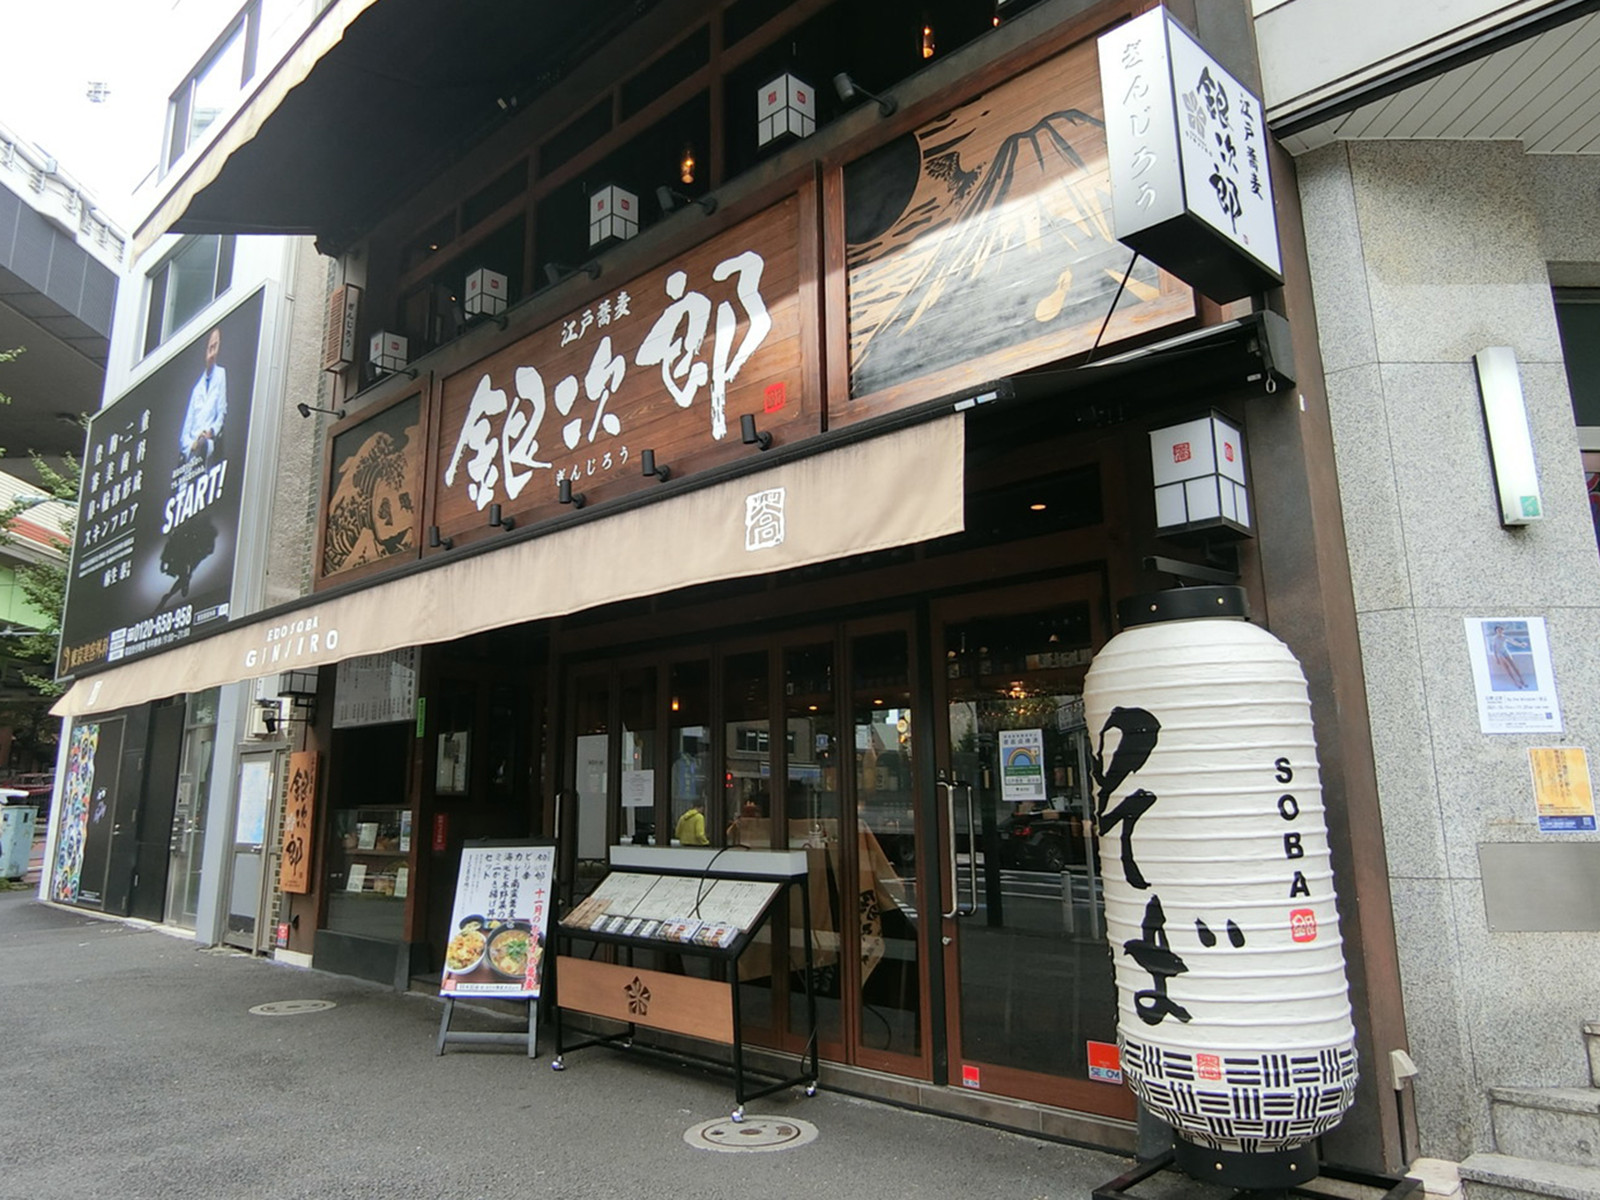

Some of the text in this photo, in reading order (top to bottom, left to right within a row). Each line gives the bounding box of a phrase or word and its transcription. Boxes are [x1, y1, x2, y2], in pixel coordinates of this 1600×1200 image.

[1121, 39, 1156, 213] ぎんじろう
[1197, 66, 1243, 234] 銀次郎
[445, 250, 772, 512] 銀次郎
[560, 291, 631, 348] 江戸蕎麦
[162, 460, 228, 534] START!
[245, 629, 338, 667] GINJIRO
[1275, 757, 1311, 898] SOBA
